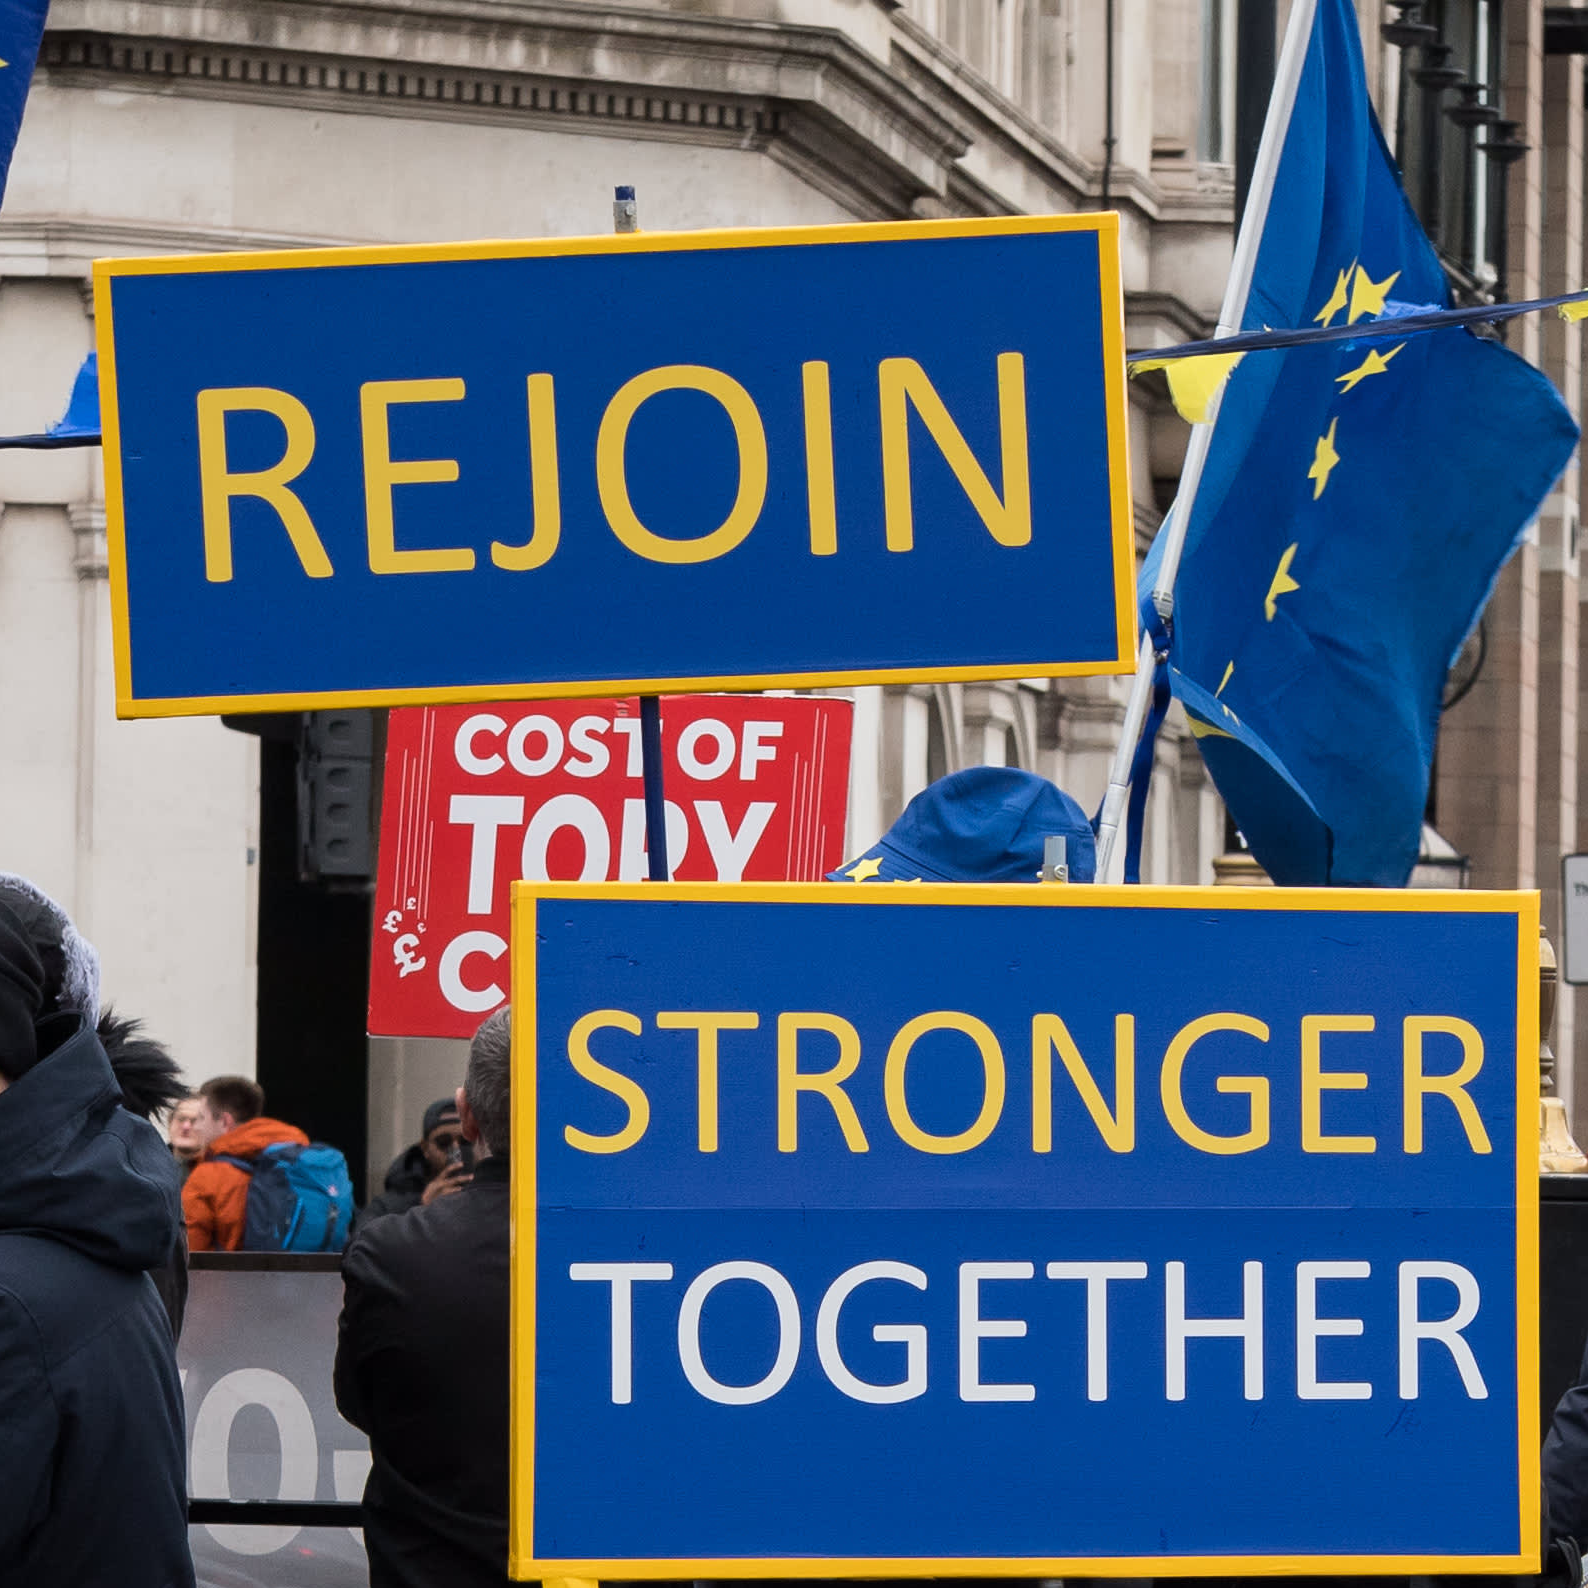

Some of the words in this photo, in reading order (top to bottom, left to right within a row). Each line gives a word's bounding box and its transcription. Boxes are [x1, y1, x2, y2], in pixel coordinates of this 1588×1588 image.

[196, 351, 1032, 583] REJOIN
[454, 713, 663, 779] COST
[676, 718, 785, 781] OF
[448, 793, 778, 915] TORY
[564, 1009, 1493, 1155] STRONGER
[569, 1260, 1489, 1405] TOGETHER
